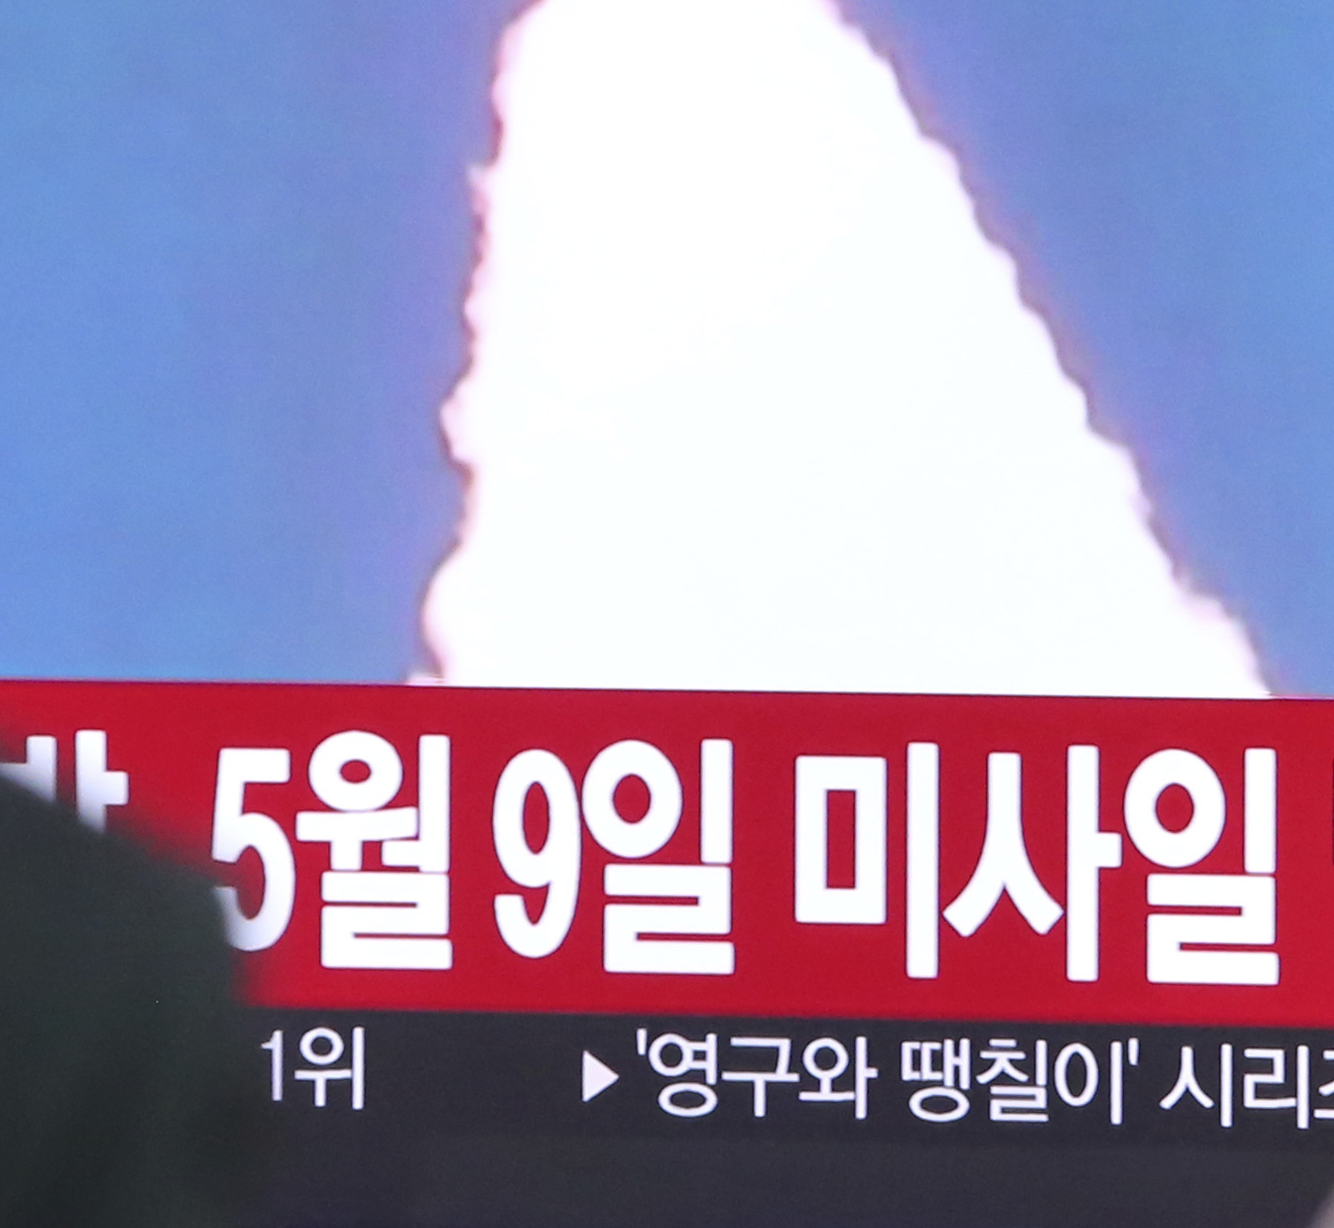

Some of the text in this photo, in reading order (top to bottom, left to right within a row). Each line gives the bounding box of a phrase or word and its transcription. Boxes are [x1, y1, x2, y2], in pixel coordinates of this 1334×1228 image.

[211, 729, 454, 971] 5월
[491, 738, 736, 976] 9일
[793, 740, 1281, 986] 미사일
[260, 1026, 365, 1111] 1위
[635, 1028, 879, 1120] '영구와
[900, 1037, 1140, 1126] 땡칠이'
